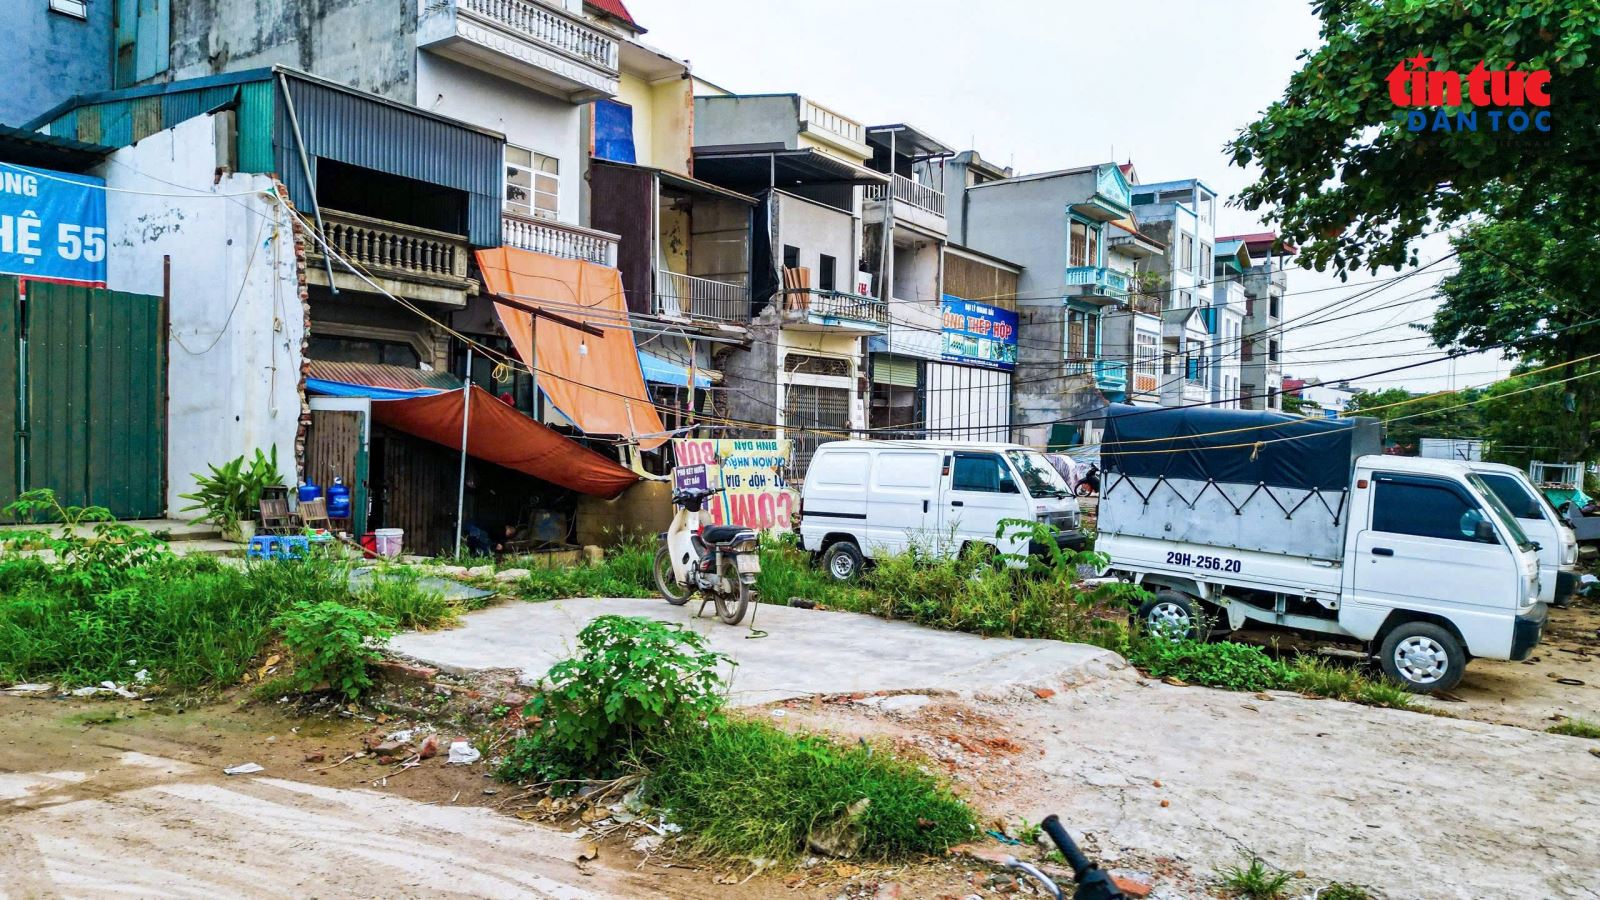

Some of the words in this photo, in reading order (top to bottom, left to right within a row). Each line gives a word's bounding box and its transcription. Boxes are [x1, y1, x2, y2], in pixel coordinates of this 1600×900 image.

[57, 222, 106, 263] 55
[966, 315, 992, 336] THÉP
[748, 472, 766, 490] HỘP
[1166, 551, 1242, 573] 29H-256.20
